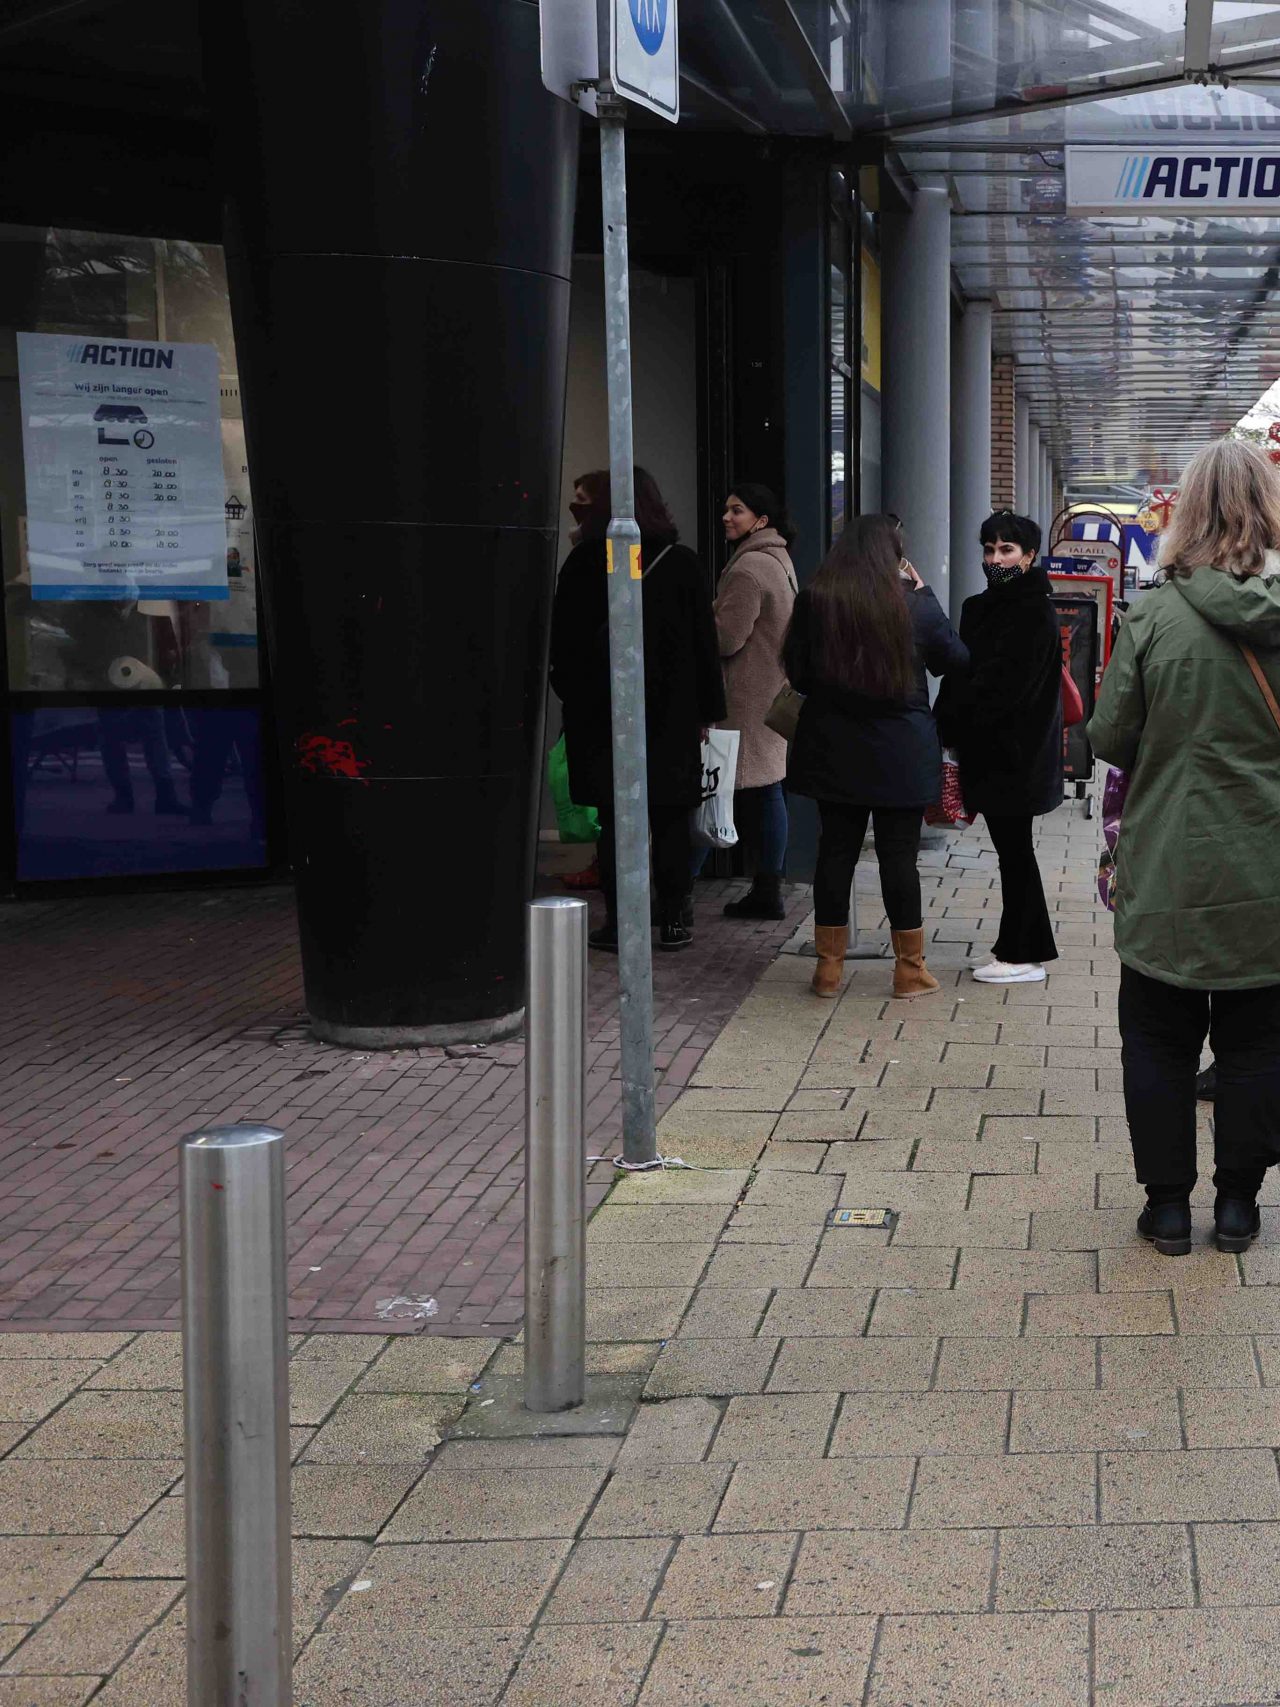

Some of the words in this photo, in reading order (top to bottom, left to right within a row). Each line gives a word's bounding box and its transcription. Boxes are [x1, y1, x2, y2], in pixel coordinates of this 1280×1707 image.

[80, 344, 174, 369] ACTION
[75, 383, 90, 393] Wij
[93, 383, 110, 394] zijn
[112, 384, 142, 395] langer
[144, 388, 168, 397] open
